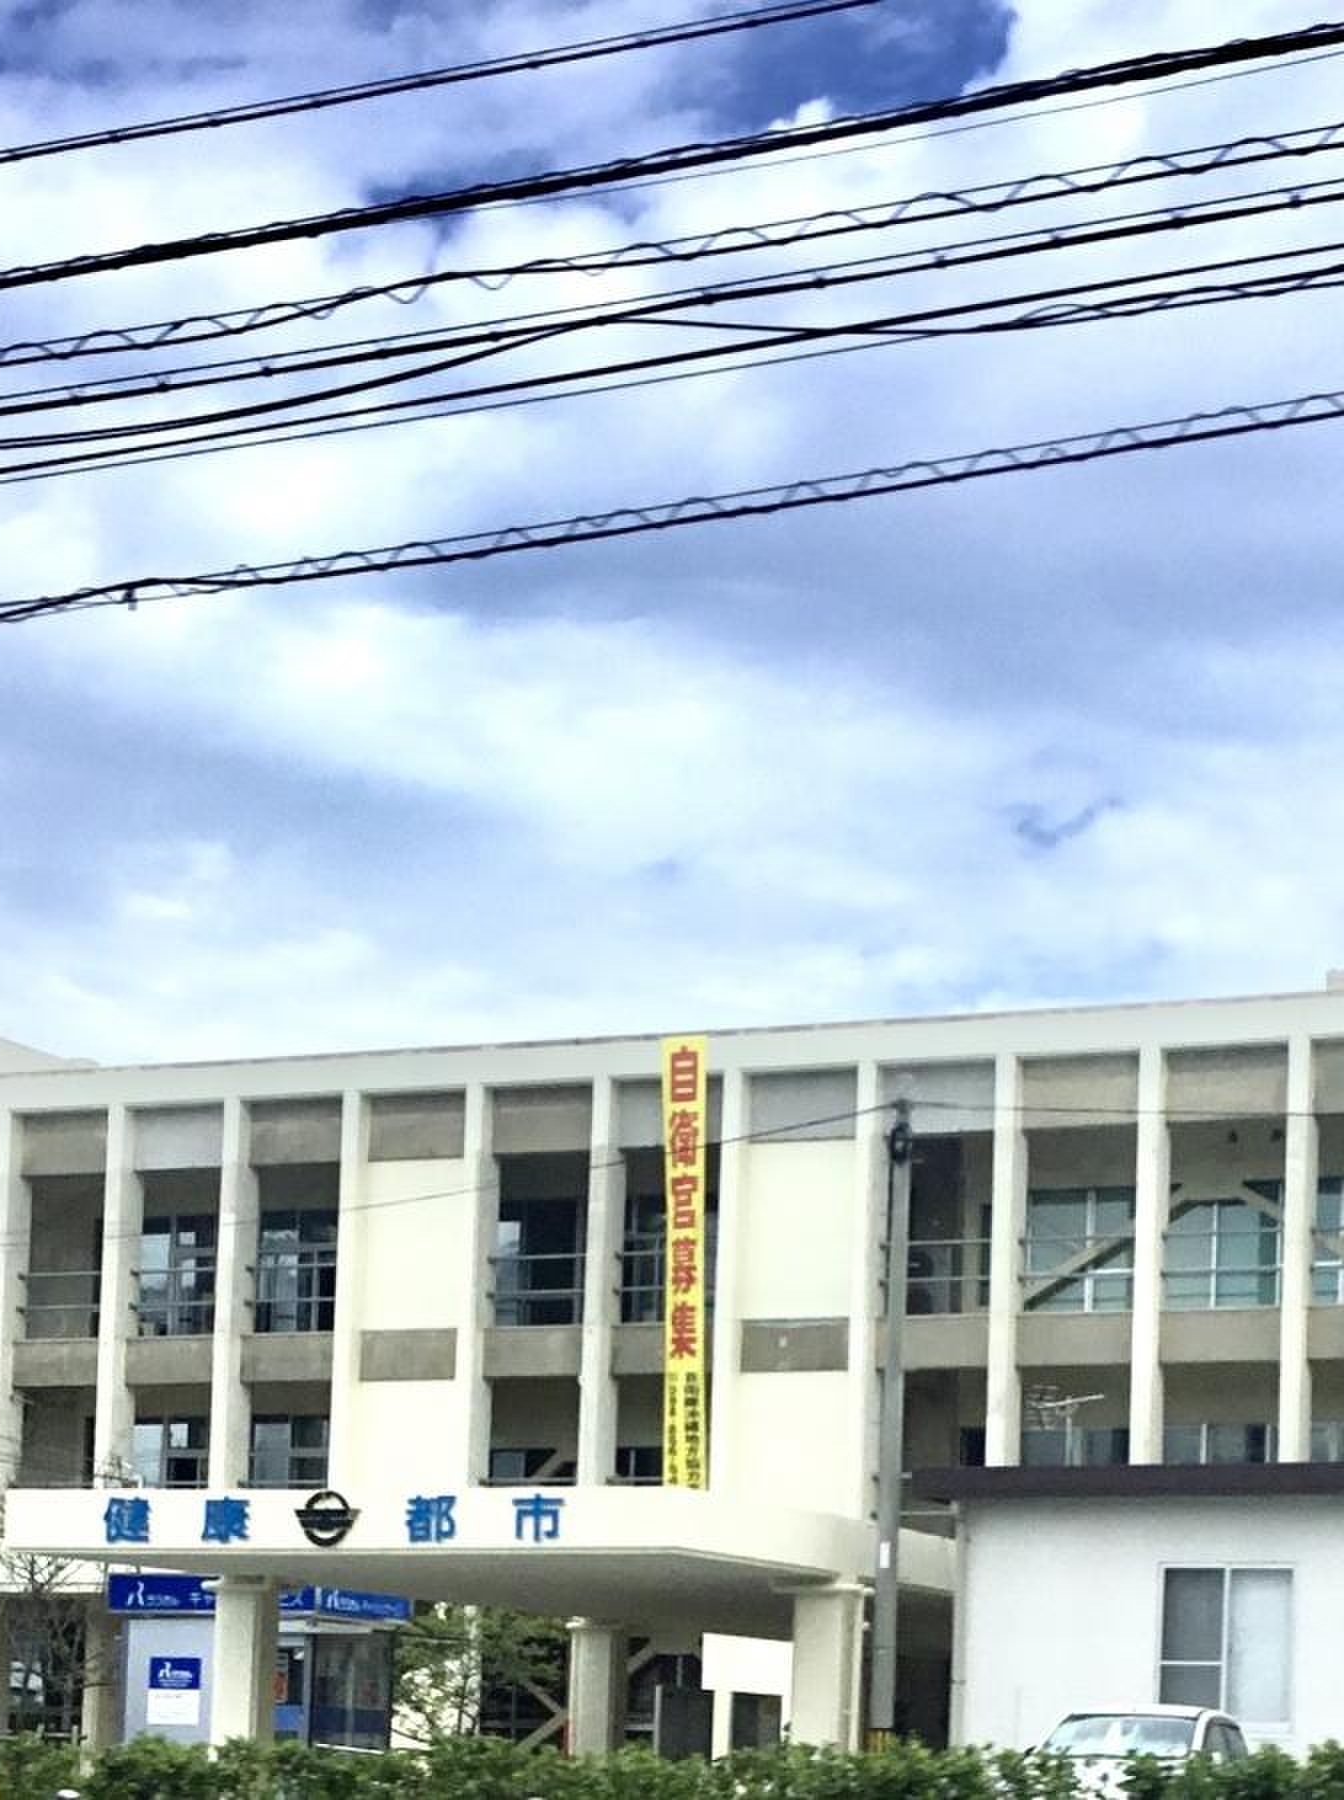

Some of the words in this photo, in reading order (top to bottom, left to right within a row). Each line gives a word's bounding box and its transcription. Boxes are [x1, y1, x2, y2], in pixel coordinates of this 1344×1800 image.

[669, 1045, 699, 1360] 自衛官募集
[103, 1496, 250, 1543] 健康
[405, 1493, 564, 1542] 都市
